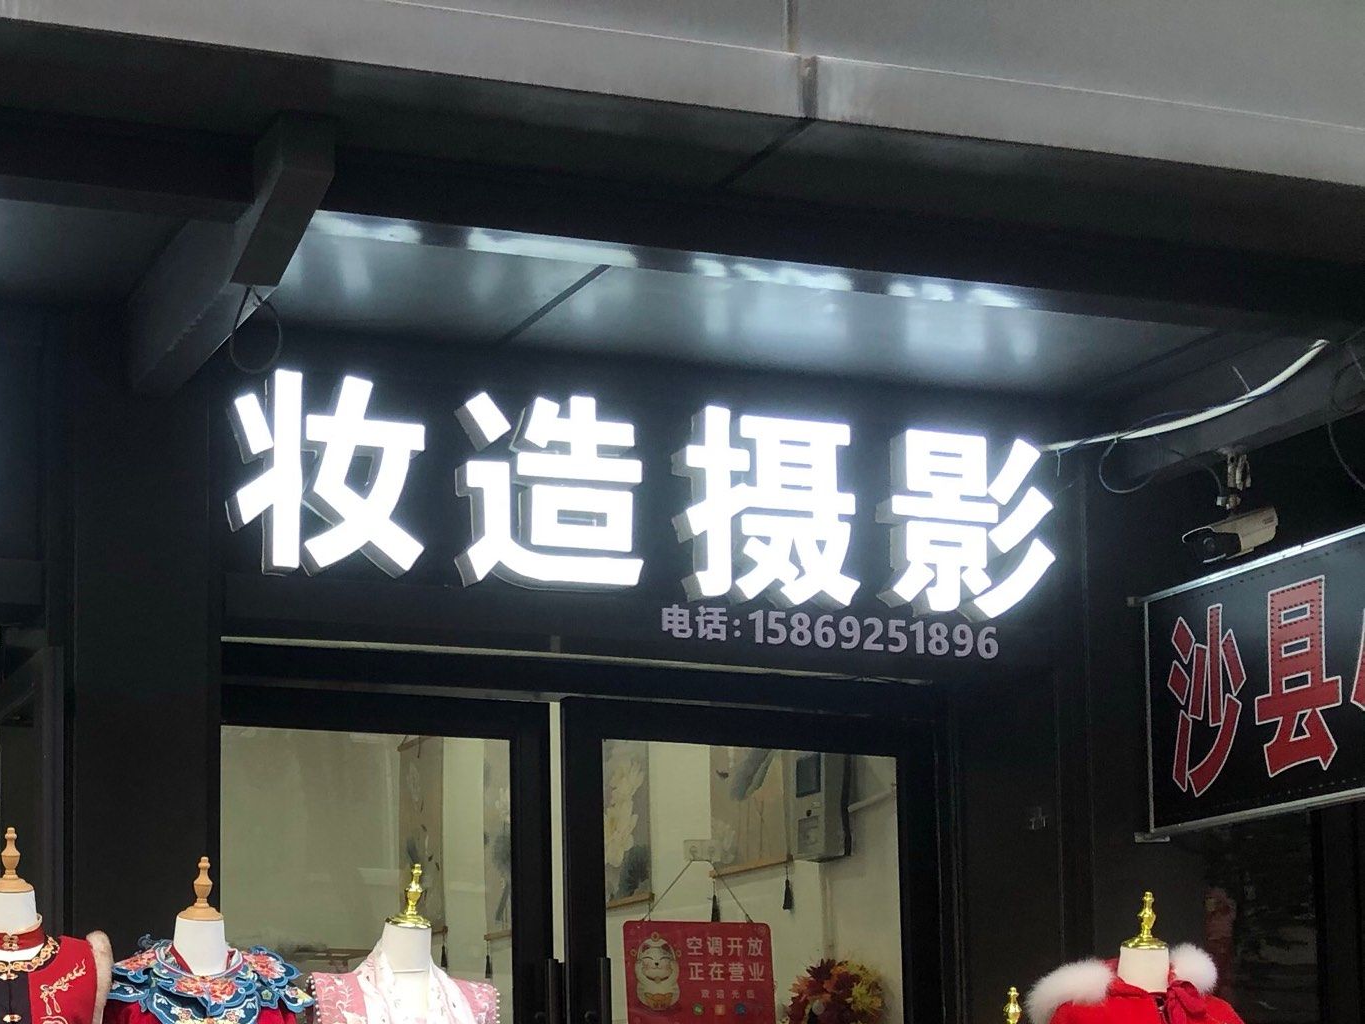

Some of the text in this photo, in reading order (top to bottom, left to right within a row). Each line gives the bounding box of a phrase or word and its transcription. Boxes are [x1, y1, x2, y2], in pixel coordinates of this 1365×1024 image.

[229, 368, 1058, 620] 妆造摄影
[661, 604, 999, 659] 电话:15869251896
[1167, 575, 1365, 797] 沙县
[686, 936, 764, 957] 空调开放
[688, 962, 765, 982] 正在营业
